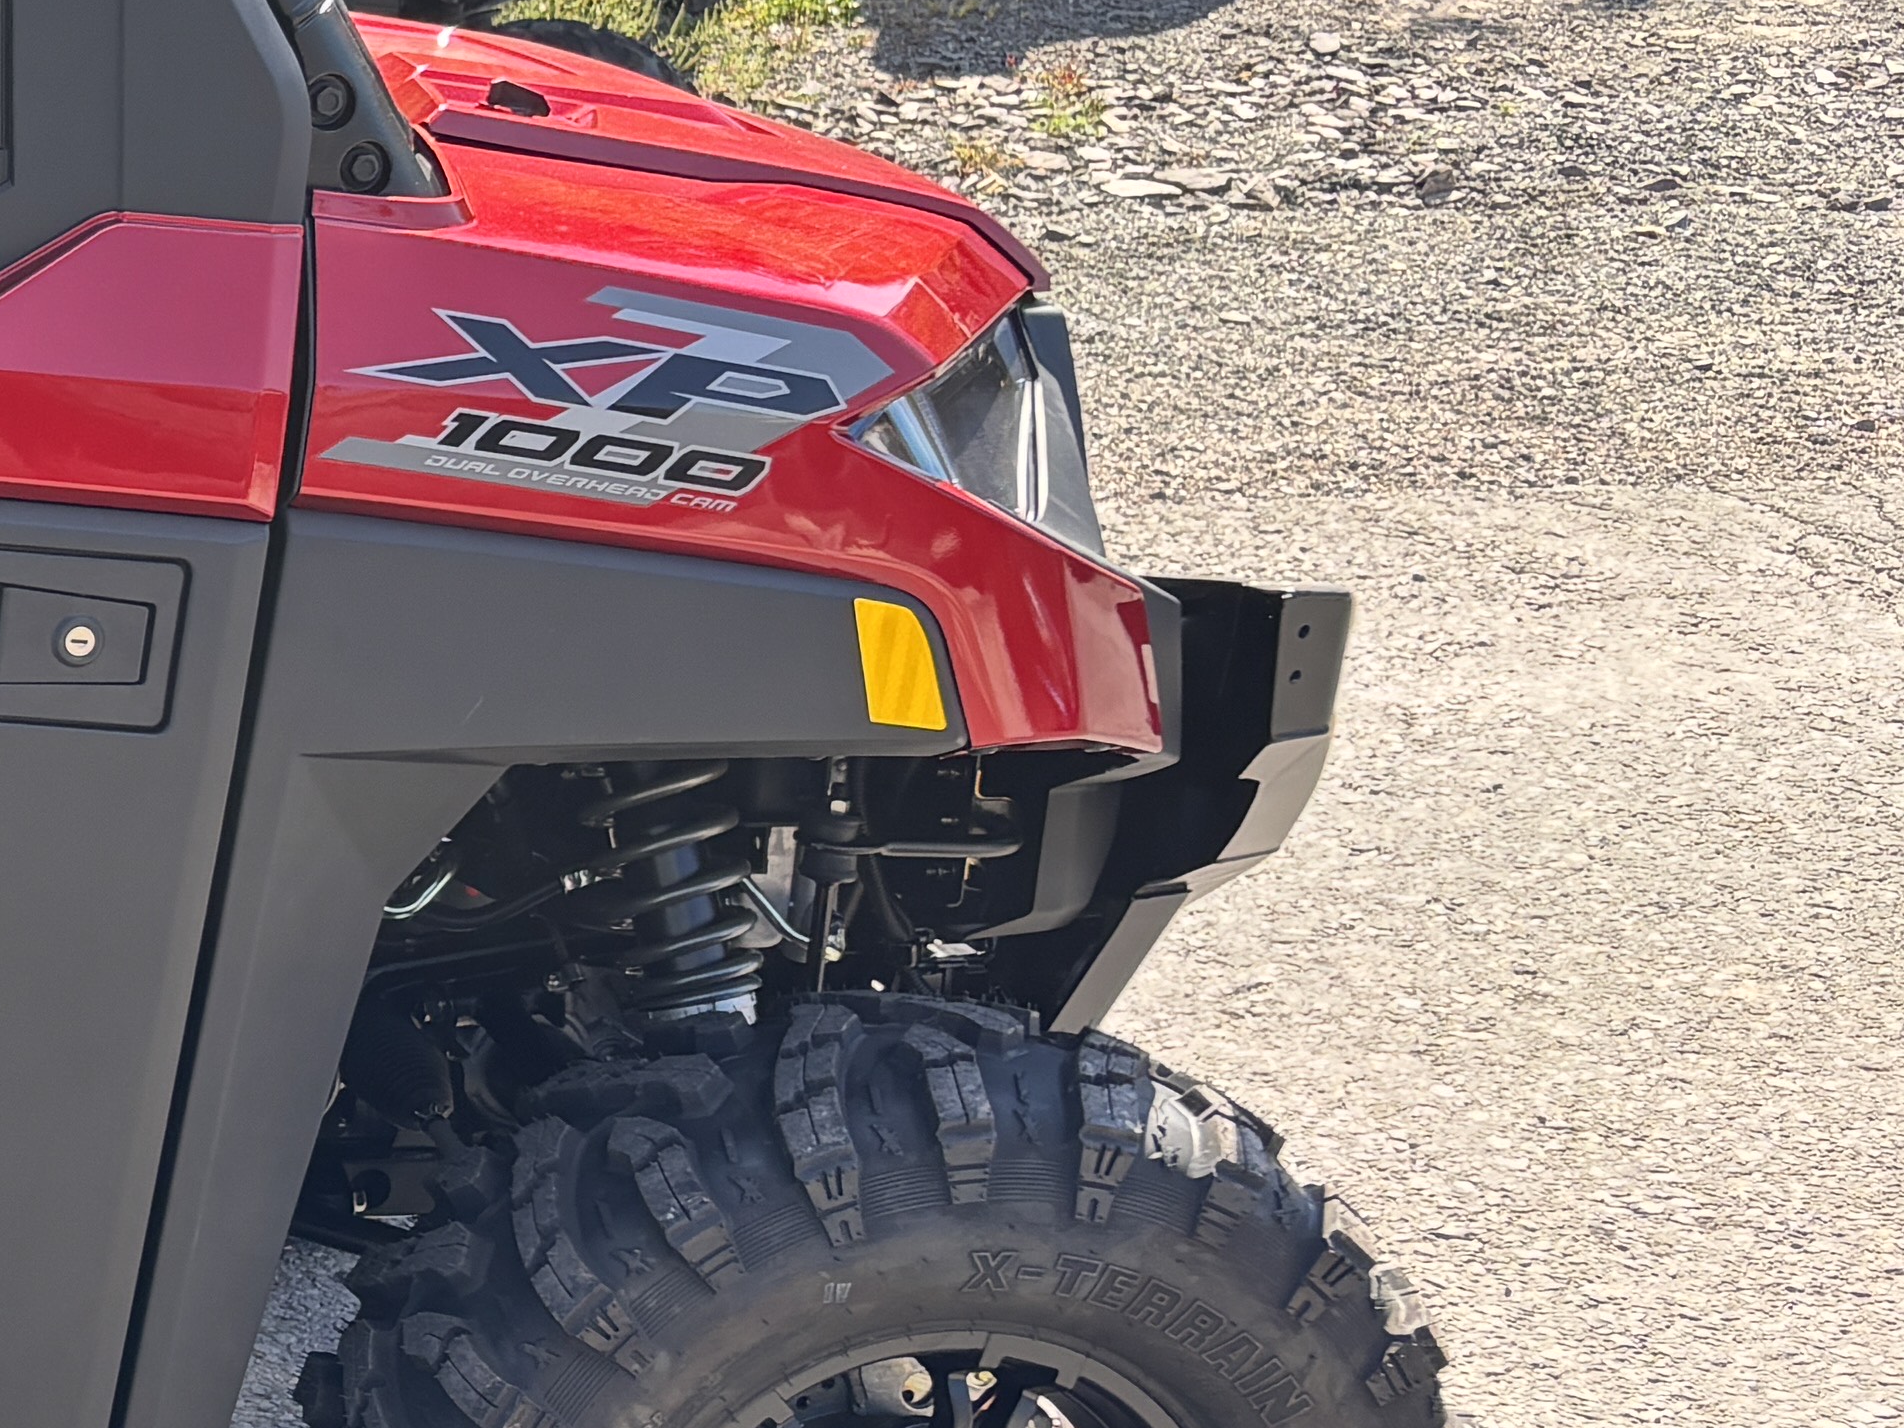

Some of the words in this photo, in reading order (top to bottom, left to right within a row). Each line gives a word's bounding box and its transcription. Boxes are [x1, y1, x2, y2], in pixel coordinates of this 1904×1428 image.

[343, 307, 848, 424] XP
[423, 454, 500, 478] DUAL
[507, 467, 669, 502] OVERHEAD
[670, 493, 738, 513] CAM
[435, 406, 773, 495] 1000
[960, 1250, 1316, 1428] X-TERRAIN
